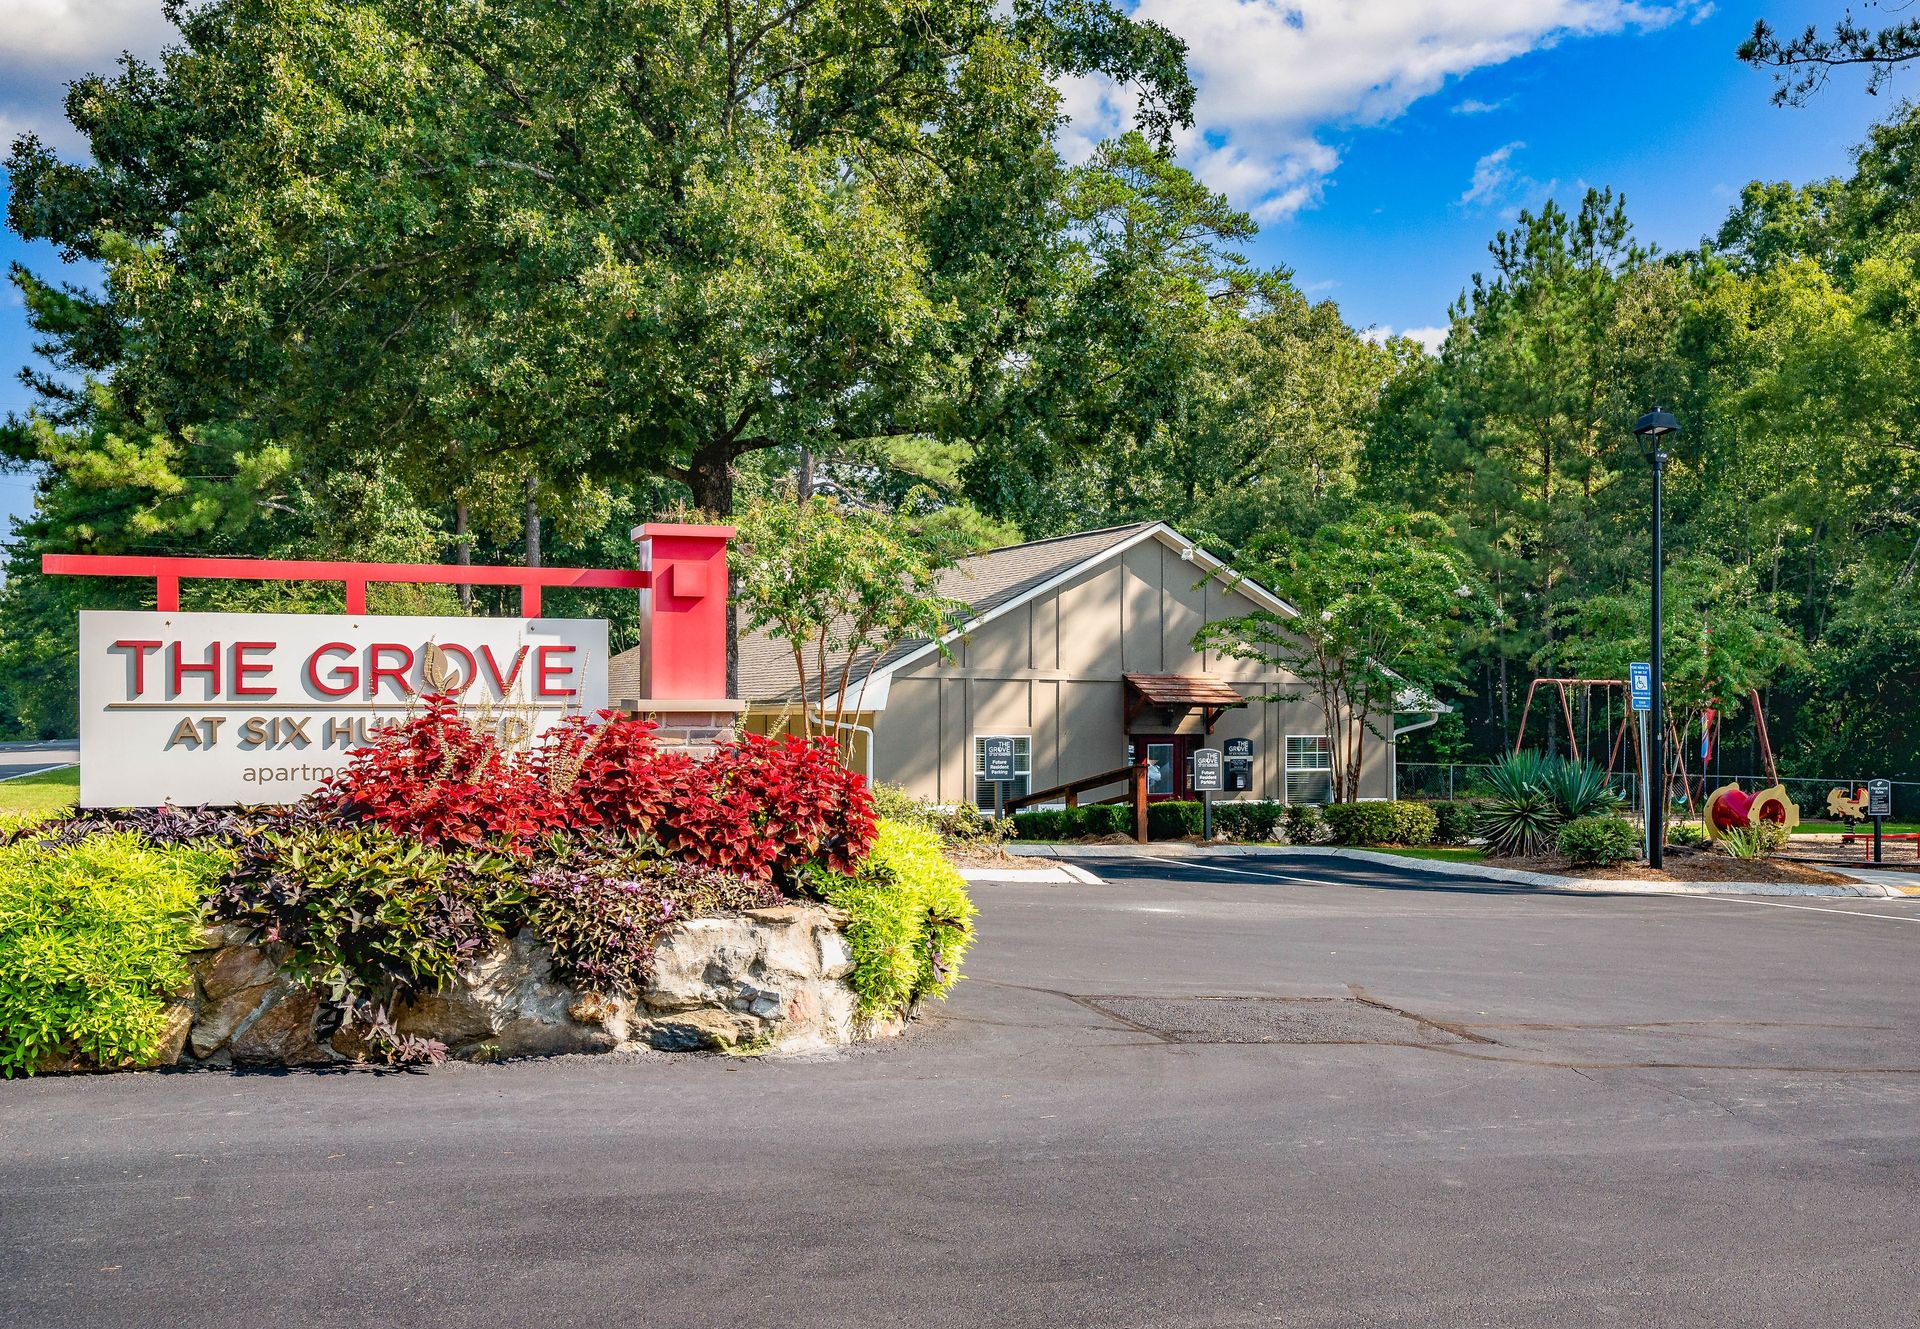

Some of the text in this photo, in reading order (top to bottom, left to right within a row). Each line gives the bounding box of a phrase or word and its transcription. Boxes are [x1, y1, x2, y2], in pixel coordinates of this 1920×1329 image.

[116, 640, 577, 696] THE GROVE
[173, 717, 226, 744] AT
[245, 717, 312, 744] SIX
[243, 763, 349, 785] apartme
